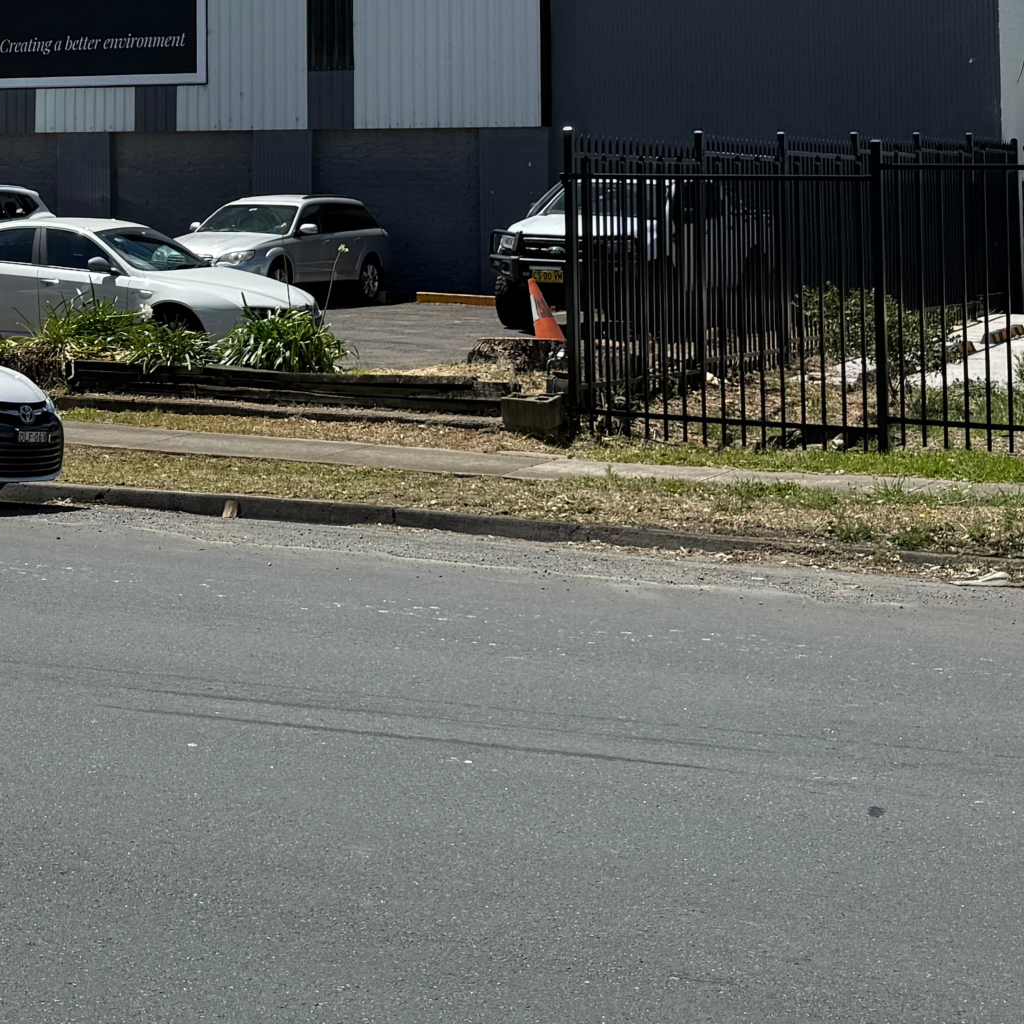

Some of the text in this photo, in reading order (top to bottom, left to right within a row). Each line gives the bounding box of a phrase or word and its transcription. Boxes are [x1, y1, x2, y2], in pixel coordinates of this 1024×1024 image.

[0, 32, 186, 55] Creating a better environment
